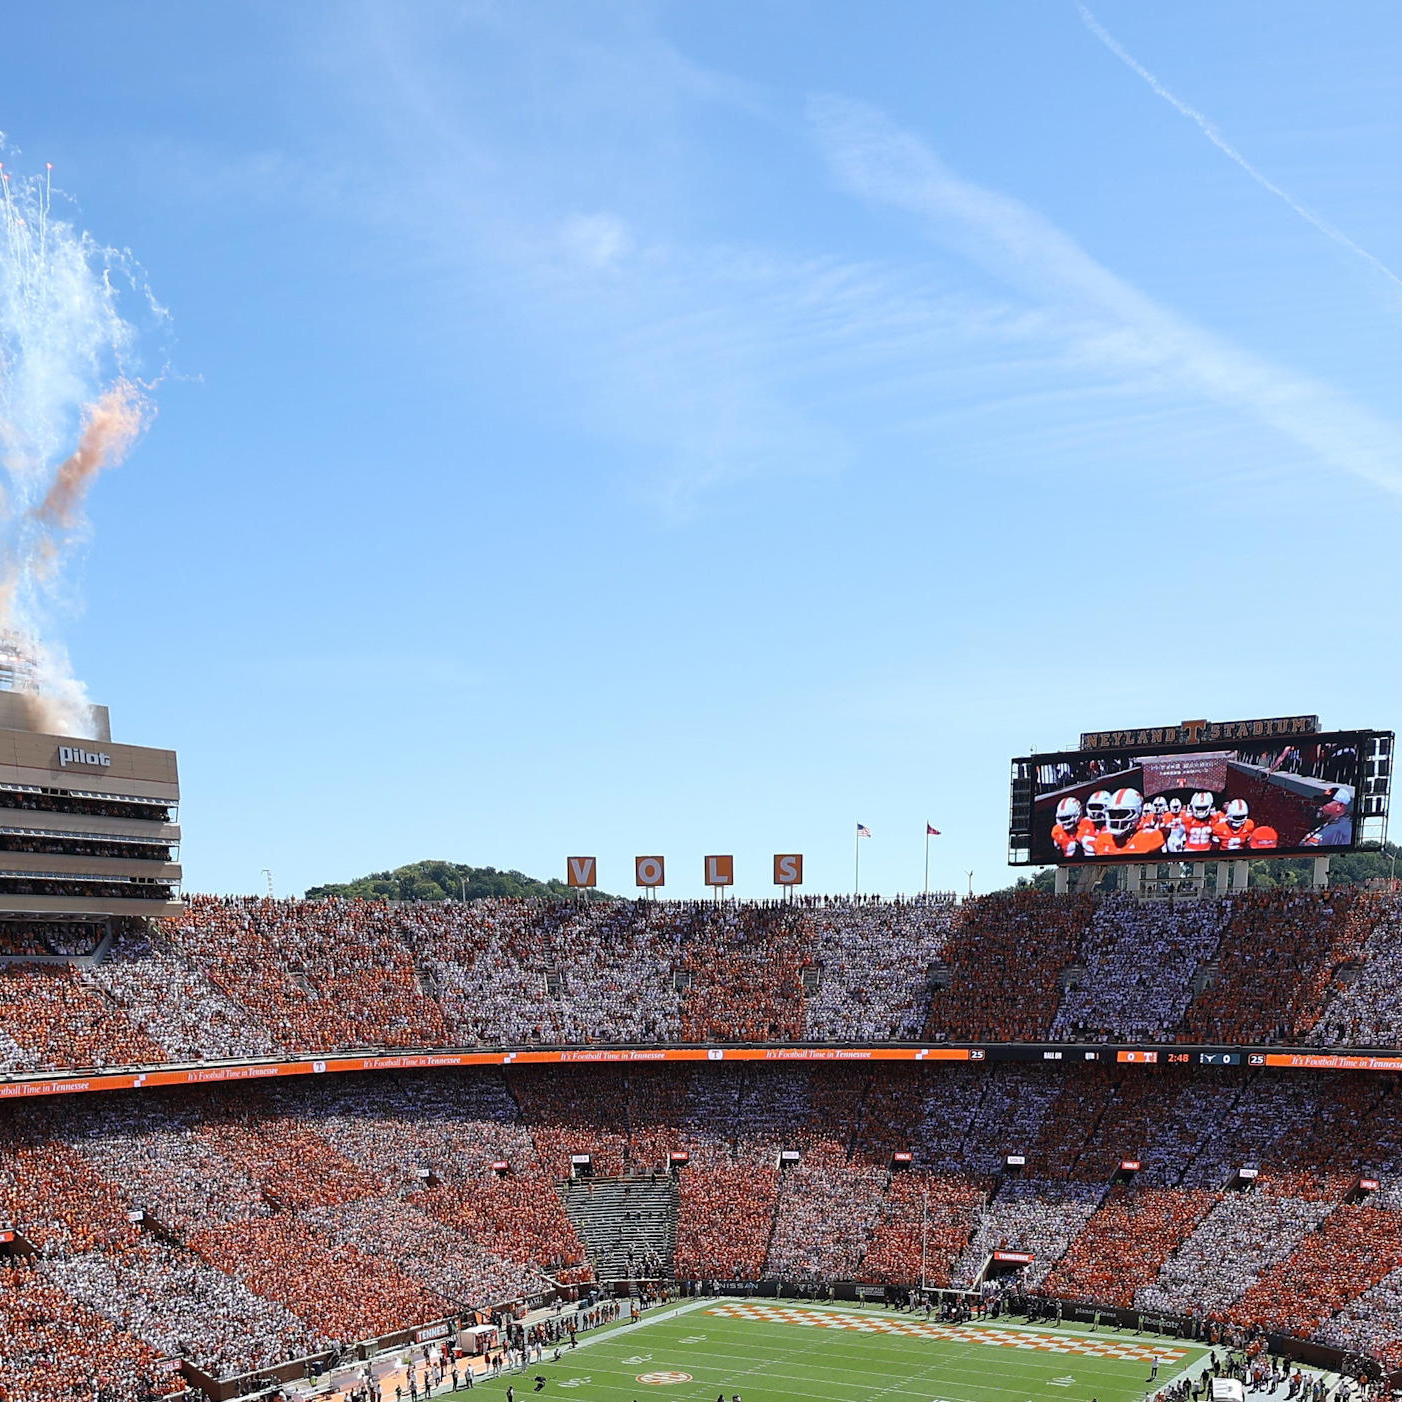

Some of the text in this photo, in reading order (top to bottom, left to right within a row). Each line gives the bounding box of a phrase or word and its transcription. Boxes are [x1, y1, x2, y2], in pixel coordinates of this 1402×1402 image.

[1086, 719, 1308, 747] NEYLAND T STADIUM
[971, 1051, 983, 1059] 25
[1127, 1053, 1134, 1061] 0
[1168, 1054, 1189, 1062] 2:48
[1222, 1055, 1230, 1063] 0
[1250, 1056, 1263, 1064] 25
[1291, 1056, 1304, 1066] It's
[1305, 1056, 1337, 1067] Football
[1339, 1057, 1358, 1067] Time
[1359, 1058, 1367, 1067] in
[22, 1084, 40, 1094] Time
[42, 1083, 50, 1092] in
[52, 1081, 90, 1092] Tennessee
